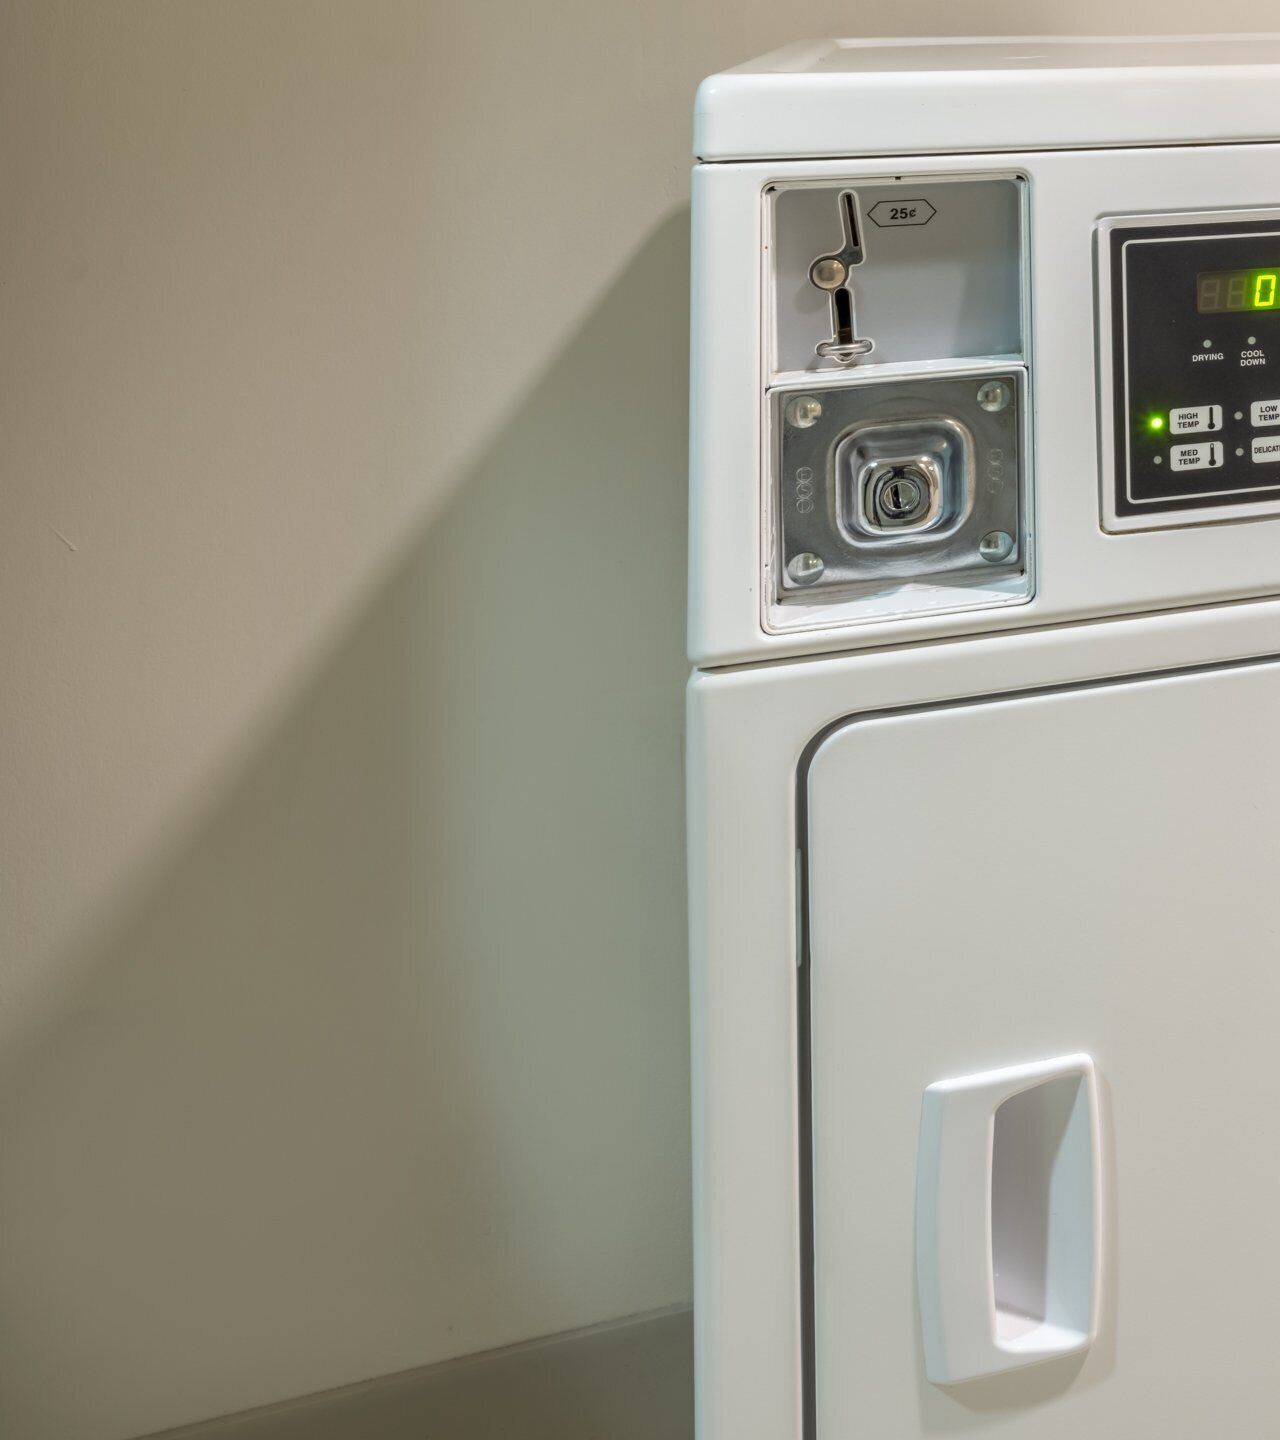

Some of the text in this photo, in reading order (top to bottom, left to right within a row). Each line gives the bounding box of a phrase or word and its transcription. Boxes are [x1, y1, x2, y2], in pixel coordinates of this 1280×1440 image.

[1192, 352, 1224, 362] DRYING
[1241, 350, 1264, 358] COOL
[1240, 358, 1265, 366] DOWN
[1260, 405, 1278, 413] LOW
[1178, 412, 1198, 420] HIGH
[1258, 413, 1280, 421] TEMP
[1177, 420, 1200, 428] TEMP
[1180, 449, 1198, 457] MED
[1178, 457, 1200, 465] TEMP
